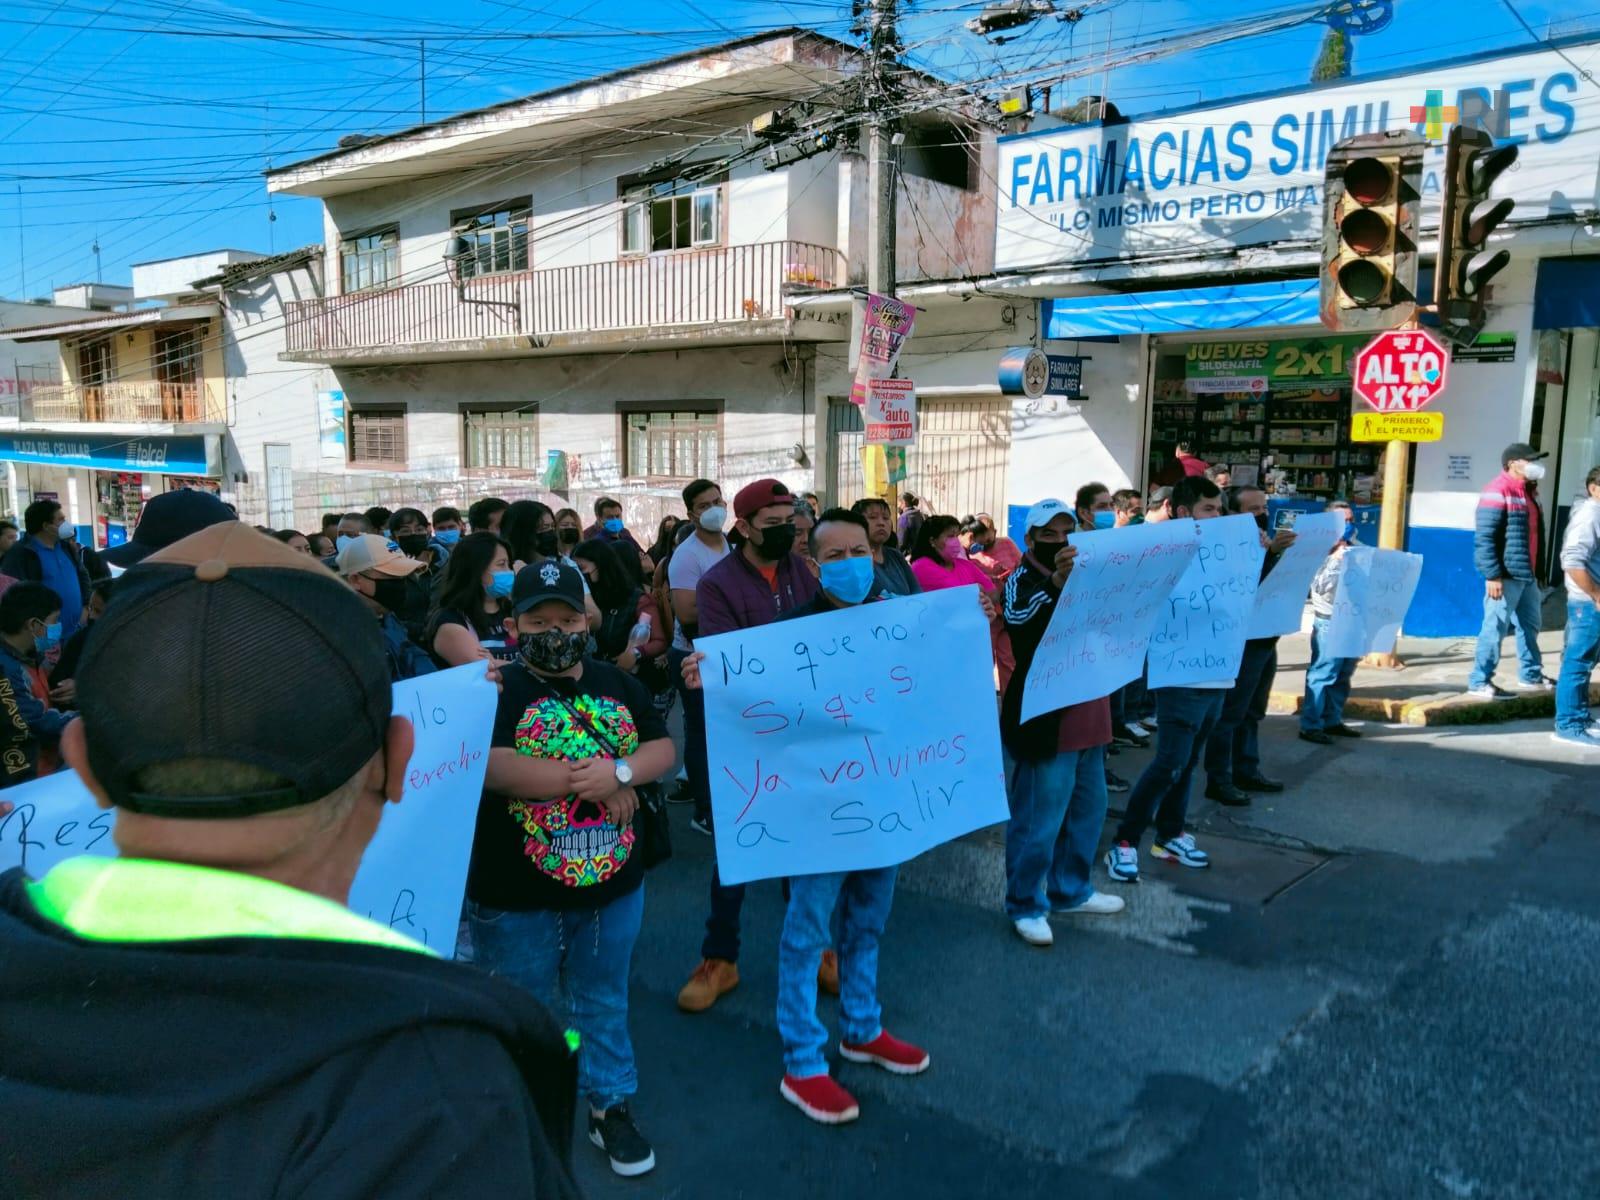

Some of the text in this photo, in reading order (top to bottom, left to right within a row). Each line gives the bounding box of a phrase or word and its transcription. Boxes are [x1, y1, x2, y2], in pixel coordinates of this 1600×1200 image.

[1011, 120, 1253, 208] FARMACIAS
[1097, 200, 1180, 229] MISMO
[1189, 191, 1266, 220] PERO
[1186, 341, 1270, 361] JUEVES
[1362, 351, 1440, 385] ALTO
[885, 408, 910, 422] auto
[1376, 427, 1389, 435] EL
[1383, 416, 1431, 426] PRIMERO
[720, 644, 766, 686] No
[793, 641, 856, 691] que
[742, 701, 804, 734] Si
[824, 687, 876, 728] que
[406, 741, 482, 792] erecho
[724, 734, 967, 825] Ya volvimos
[736, 780, 964, 848] a Salir
